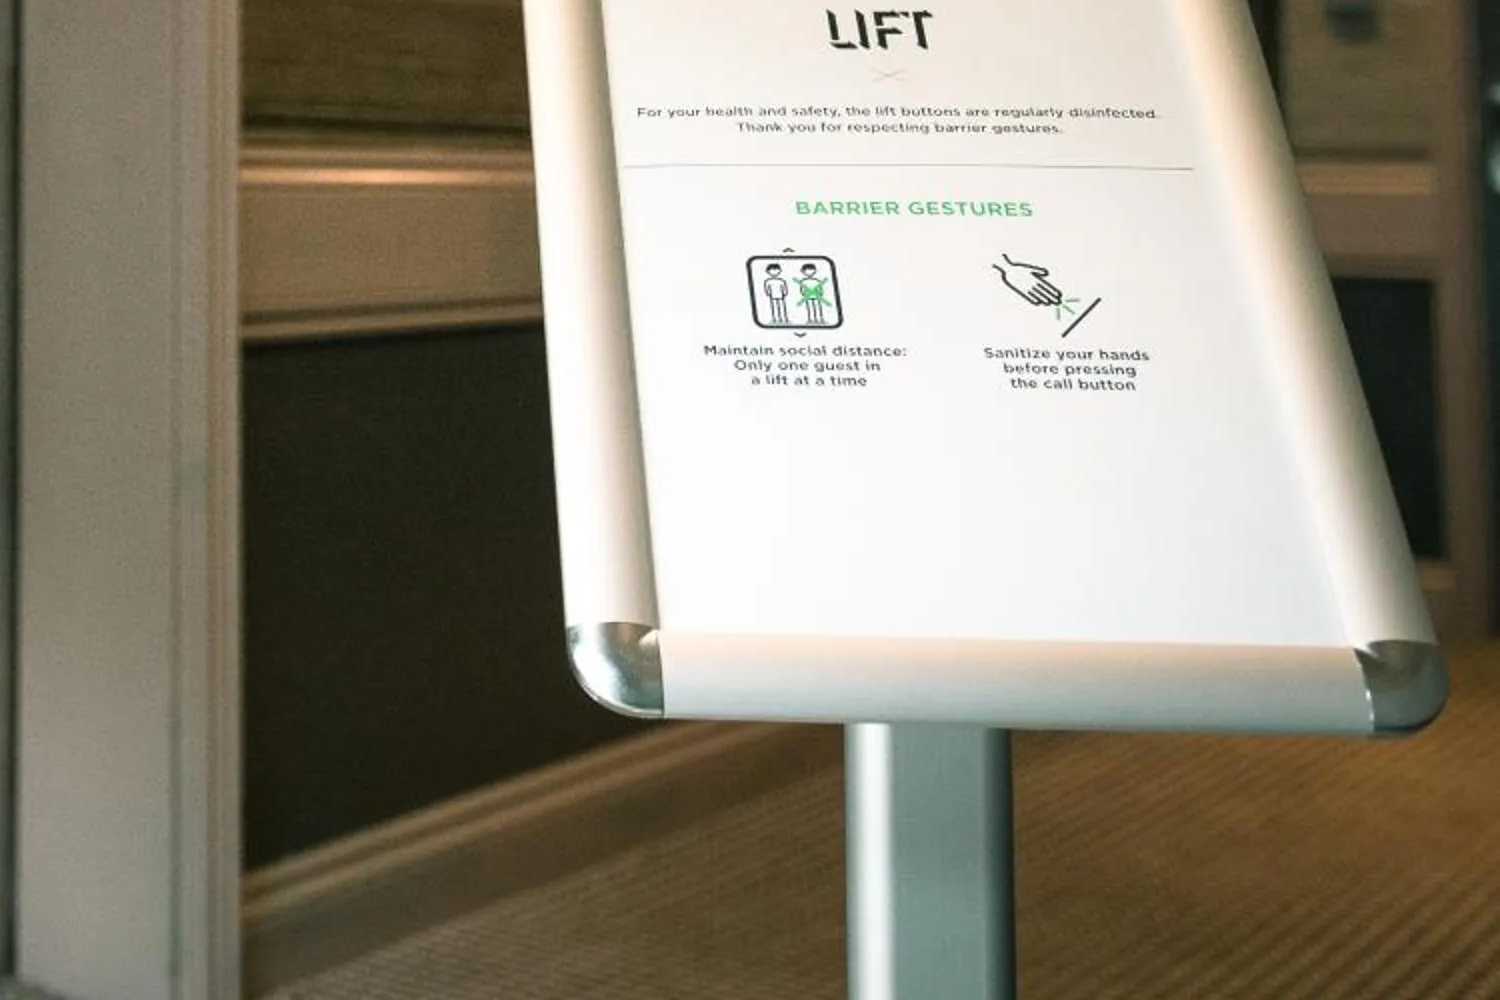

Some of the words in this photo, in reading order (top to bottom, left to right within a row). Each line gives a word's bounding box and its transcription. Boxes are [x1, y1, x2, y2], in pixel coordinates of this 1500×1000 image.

[825, 8, 935, 51] LIFT
[637, 107, 662, 118] For
[667, 109, 700, 119] your
[704, 106, 753, 117] health
[758, 106, 787, 117] and
[791, 106, 841, 119] safety,
[845, 106, 871, 117] the
[875, 106, 896, 117] lift
[901, 106, 961, 118] buttons
[965, 109, 990, 118] are
[994, 106, 1064, 119] regularly
[736, 122, 783, 133] Thank
[787, 124, 817, 134] you
[821, 122, 843, 133] for
[847, 122, 930, 135] respecting
[934, 122, 988, 133] barrier
[991, 123, 1063, 135] gestures.
[796, 201, 900, 215] BARRIER
[908, 201, 1033, 217] GESTURES
[703, 344, 774, 357] Maintain
[779, 345, 827, 357] social
[832, 344, 908, 357] distance:
[983, 347, 1051, 360] Sanitize
[1055, 350, 1094, 361] your
[1098, 348, 1150, 361] hands
[733, 359, 772, 373] Only
[778, 361, 809, 371] one
[814, 360, 859, 373] guest
[865, 359, 881, 372] in
[1003, 362, 1059, 375] before
[1063, 364, 1137, 378] pressing
[751, 376, 761, 386] a
[766, 374, 788, 386] lift
[794, 375, 810, 386] at
[815, 377, 825, 387] a
[830, 375, 867, 387] time
[1010, 377, 1038, 389] the
[1043, 377, 1073, 390] call
[1077, 378, 1136, 391] button
